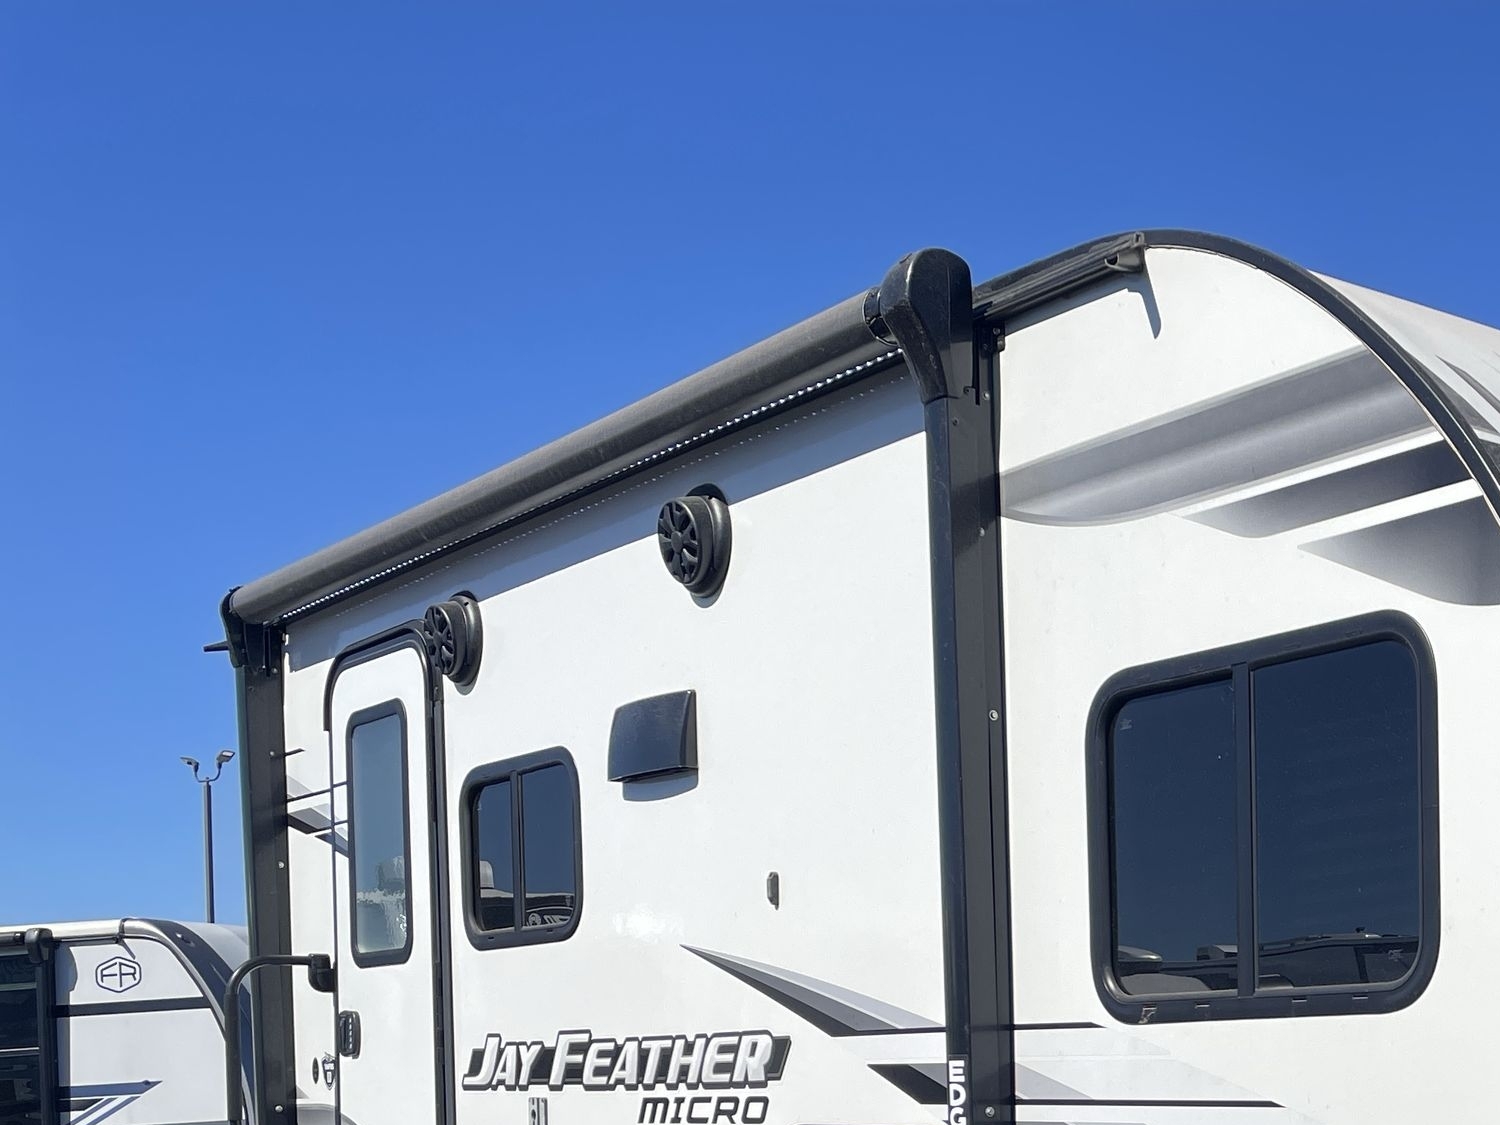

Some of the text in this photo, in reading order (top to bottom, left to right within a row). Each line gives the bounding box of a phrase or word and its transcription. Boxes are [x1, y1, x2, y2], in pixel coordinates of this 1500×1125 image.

[462, 1029, 774, 1091] JAY FEATHER
[638, 1097, 769, 1125] MICRO
